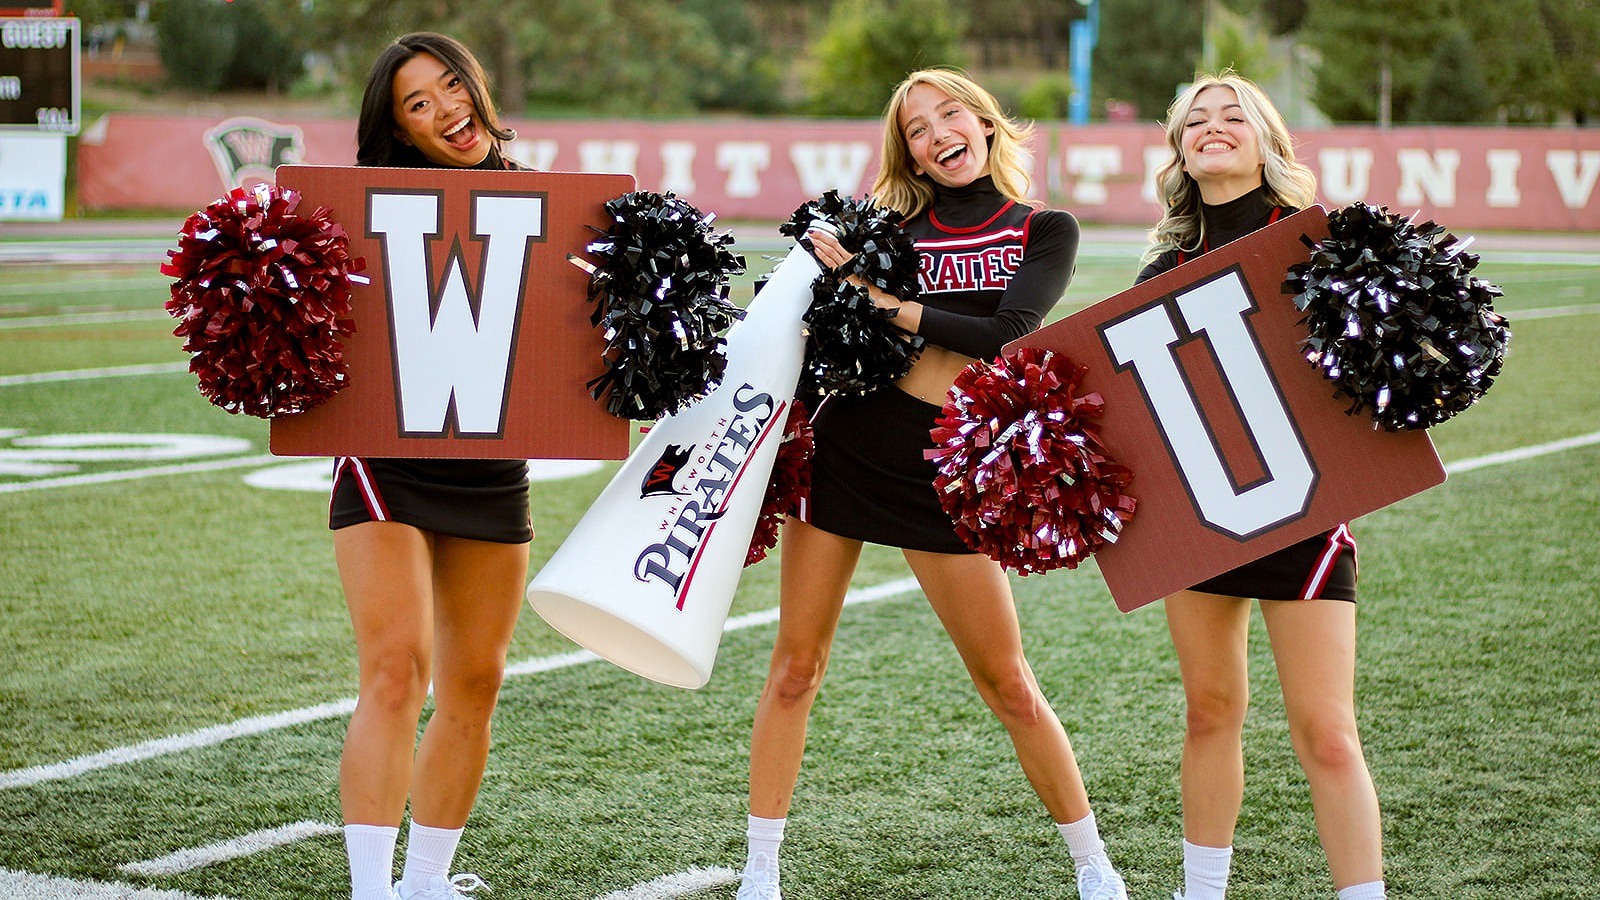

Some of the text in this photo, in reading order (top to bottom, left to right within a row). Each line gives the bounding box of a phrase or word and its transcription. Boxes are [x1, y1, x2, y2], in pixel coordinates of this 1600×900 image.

[2, 21, 67, 49] GUEST
[1319, 148, 1600, 208] UNIV
[917, 245, 1024, 295] RATES
[364, 187, 548, 440] W
[1095, 262, 1321, 543] U
[634, 382, 775, 598] PIRATES
[647, 460, 676, 488] W
[660, 418, 727, 531] WHITWORTH
